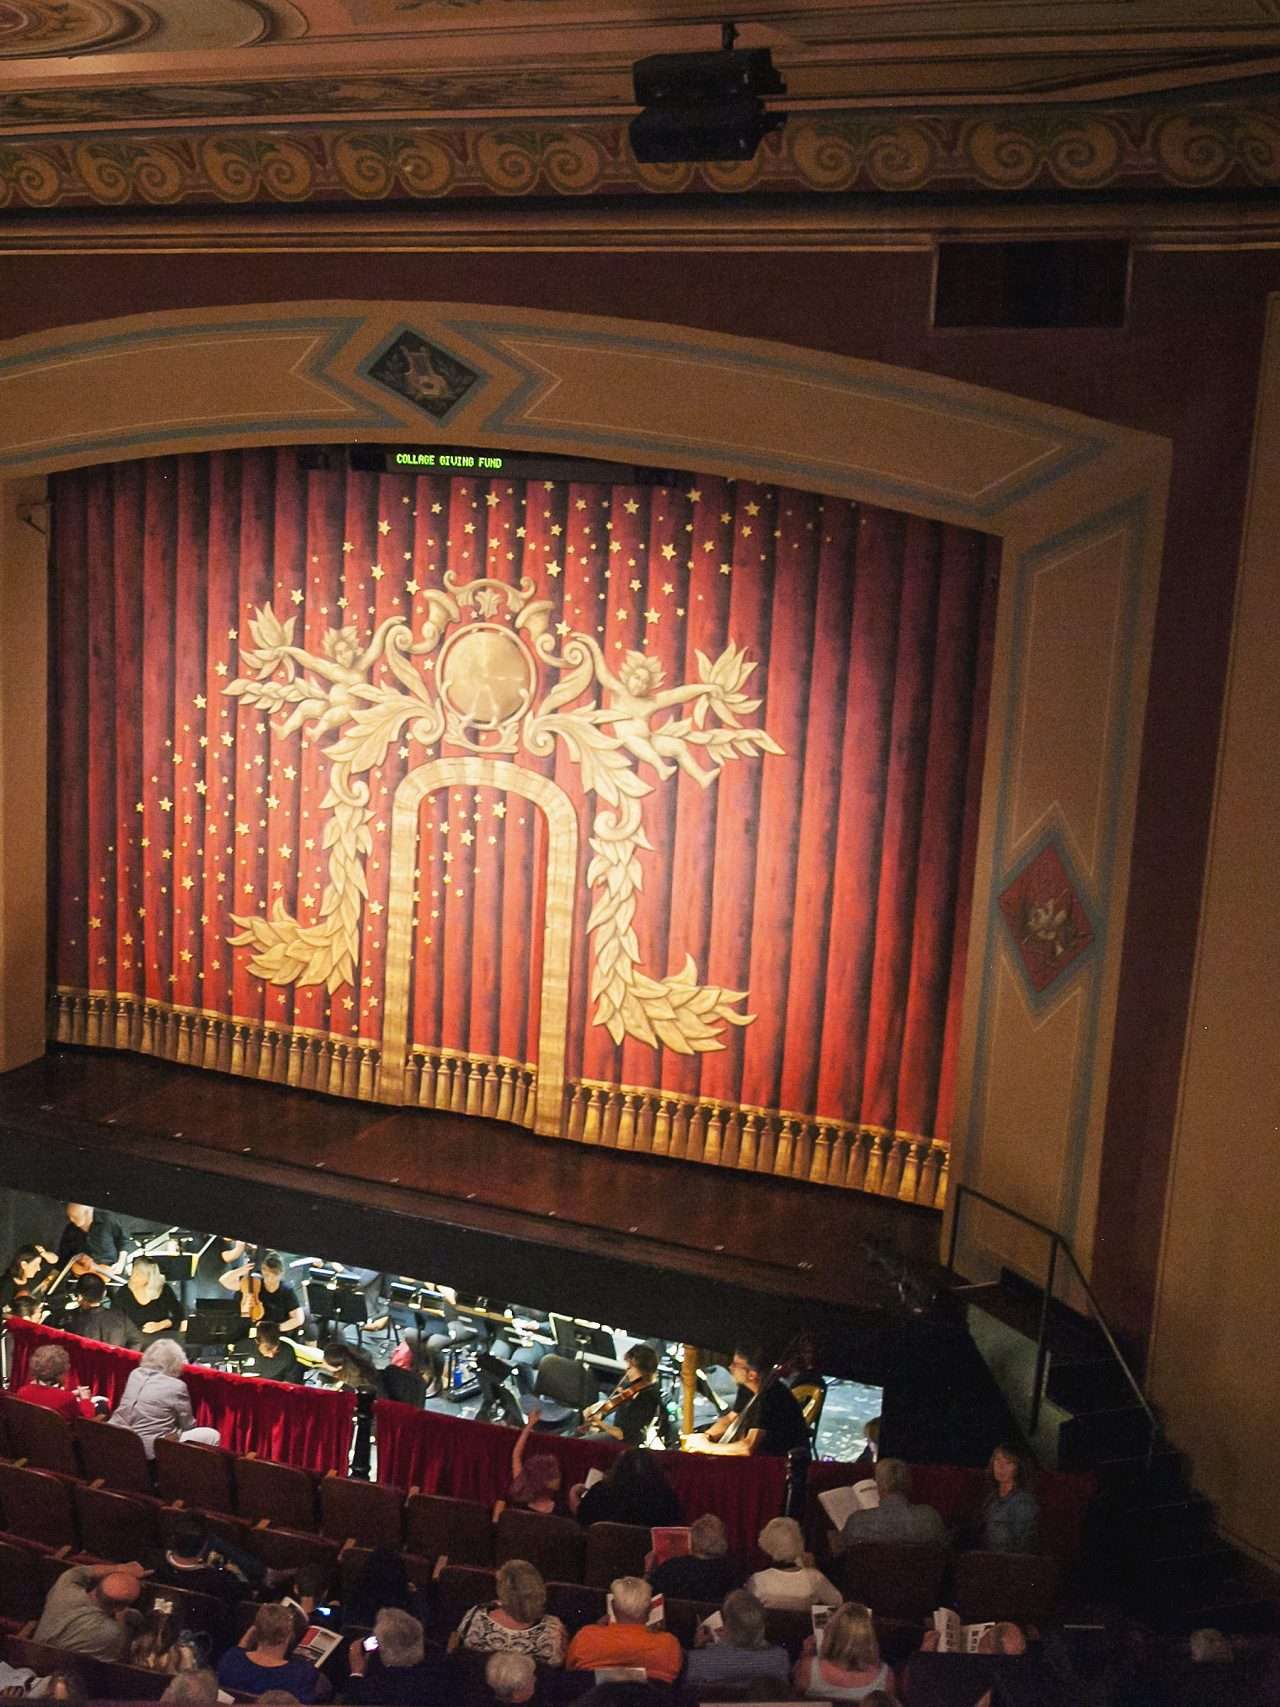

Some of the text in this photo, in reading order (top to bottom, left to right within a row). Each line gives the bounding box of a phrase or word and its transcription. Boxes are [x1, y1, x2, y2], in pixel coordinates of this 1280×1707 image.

[396, 453, 502, 469] COLLAGE GIVING FUND
